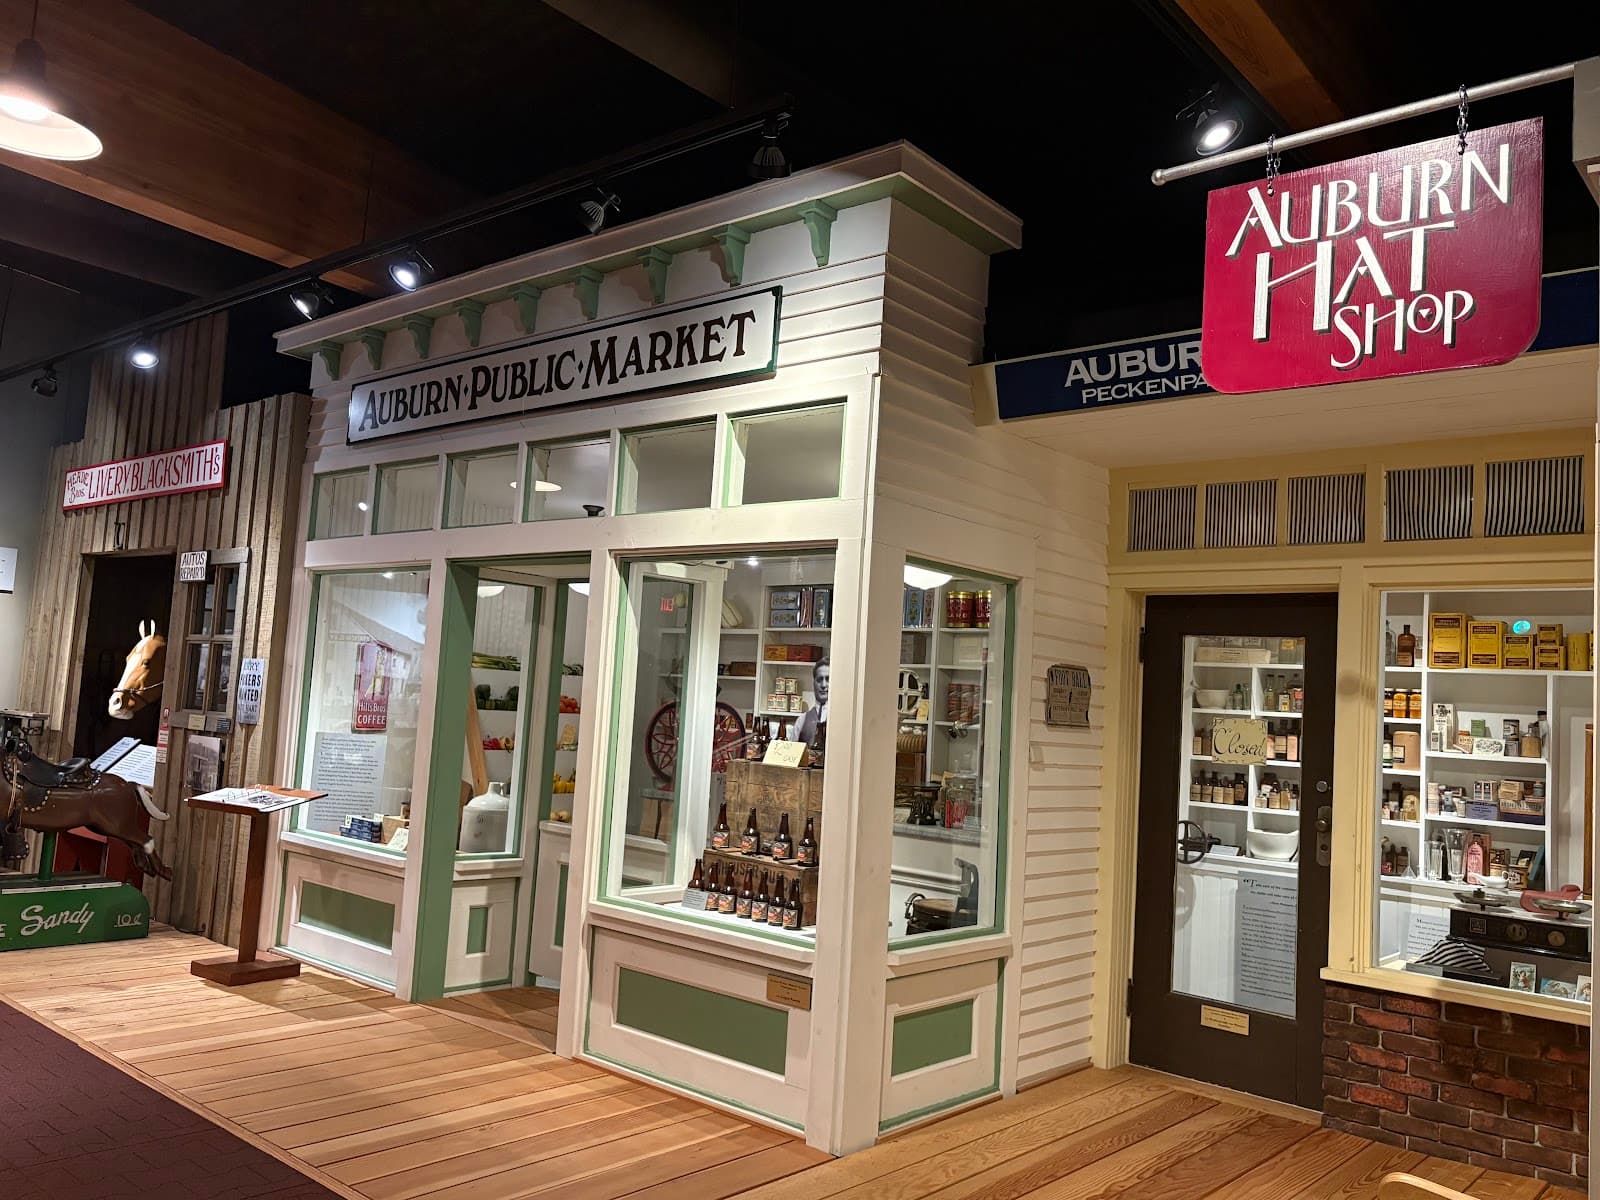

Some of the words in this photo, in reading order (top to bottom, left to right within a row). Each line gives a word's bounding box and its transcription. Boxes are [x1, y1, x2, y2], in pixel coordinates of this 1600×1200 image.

[1225, 144, 1510, 257] AUBURN
[1253, 221, 1455, 340] HAT
[1331, 290, 1474, 368] SHOP
[359, 375, 463, 432] AUBURN
[468, 349, 576, 411] PUBLIC
[582, 310, 756, 389] MARKET
[182, 552, 206, 567] AUTOS
[357, 714, 386, 725] COFFEE
[1213, 727, 1266, 757] Closed
[20, 902, 95, 936] Sandy
